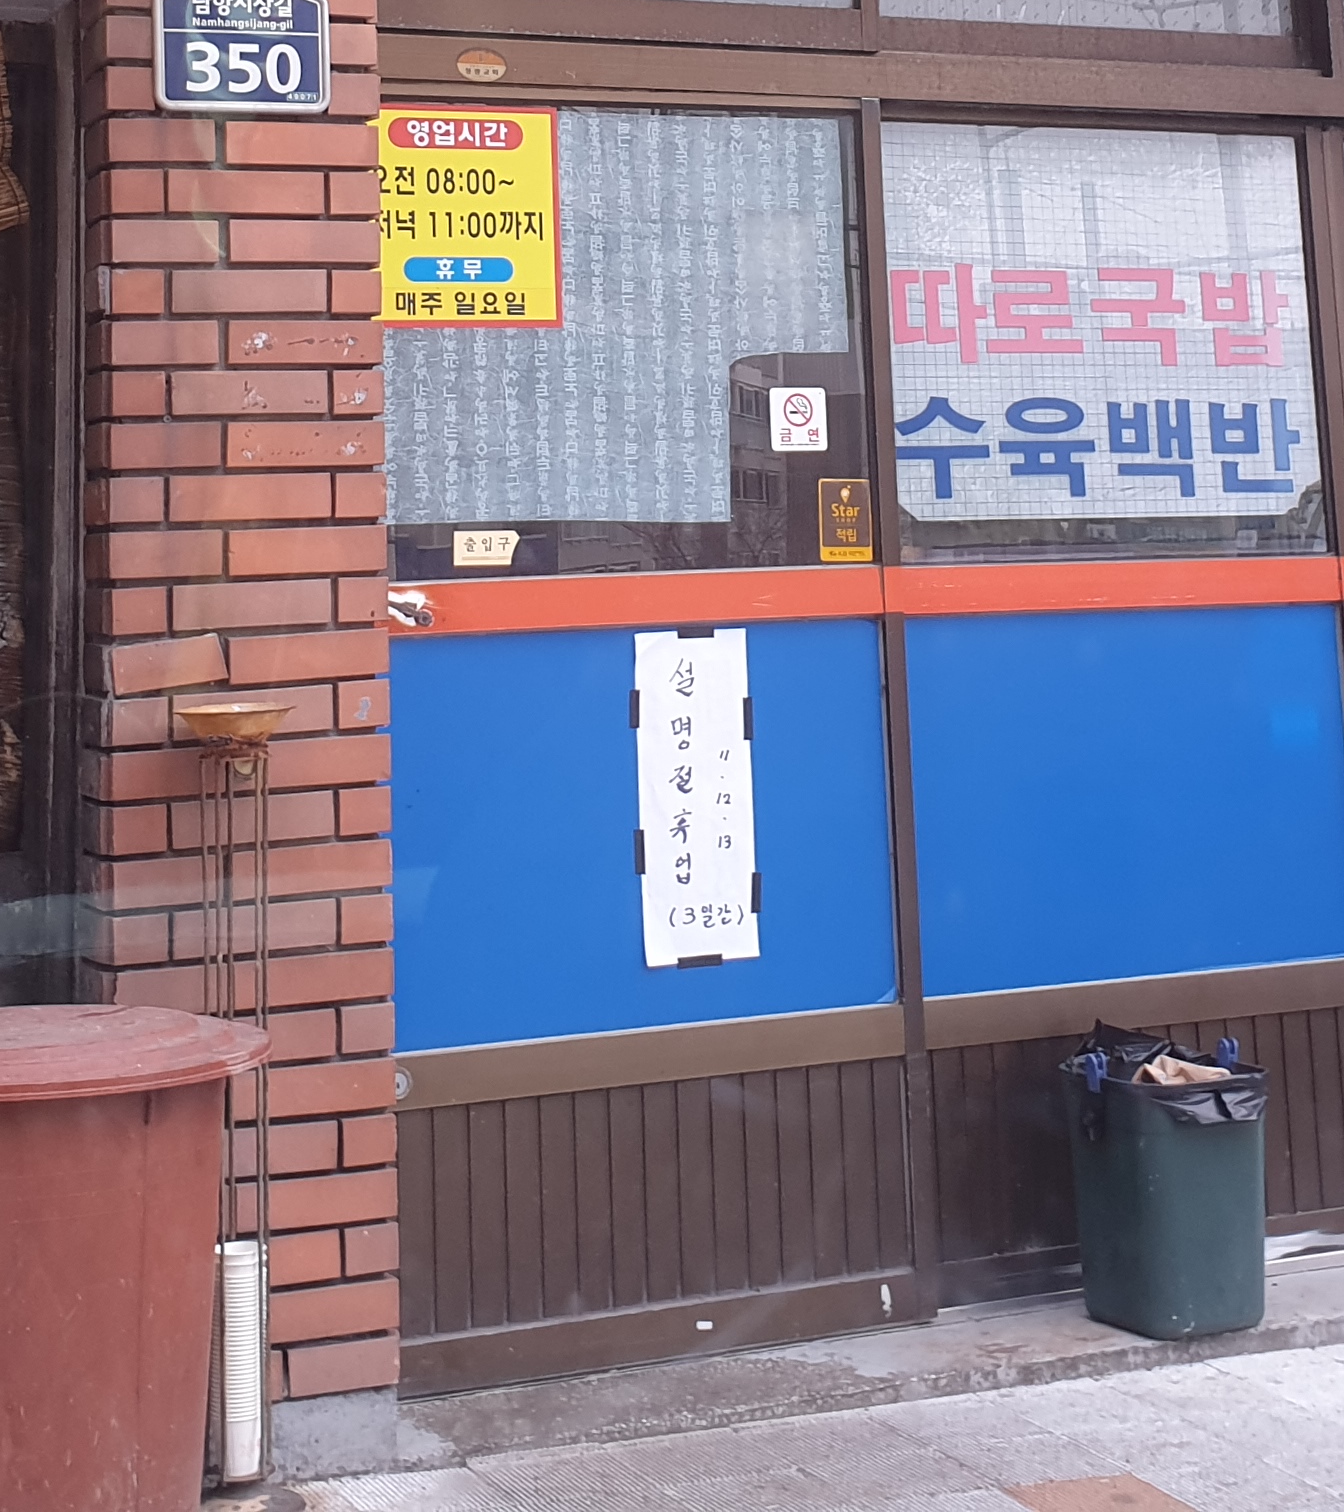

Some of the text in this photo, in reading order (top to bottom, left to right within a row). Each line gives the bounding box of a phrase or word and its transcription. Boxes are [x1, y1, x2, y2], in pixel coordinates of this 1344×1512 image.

[192, 16, 294, 30] Namhangsijang-gil
[185, 41, 302, 94] 350
[406, 119, 508, 147] 영업시간
[425, 167, 515, 195] 08:00~
[428, 210, 544, 241] 11:00까지
[395, 291, 526, 316] 매주 일요일
[889, 263, 1289, 367] 따로국밥
[894, 396, 1301, 500] 수육백반
[831, 503, 860, 518] Star
